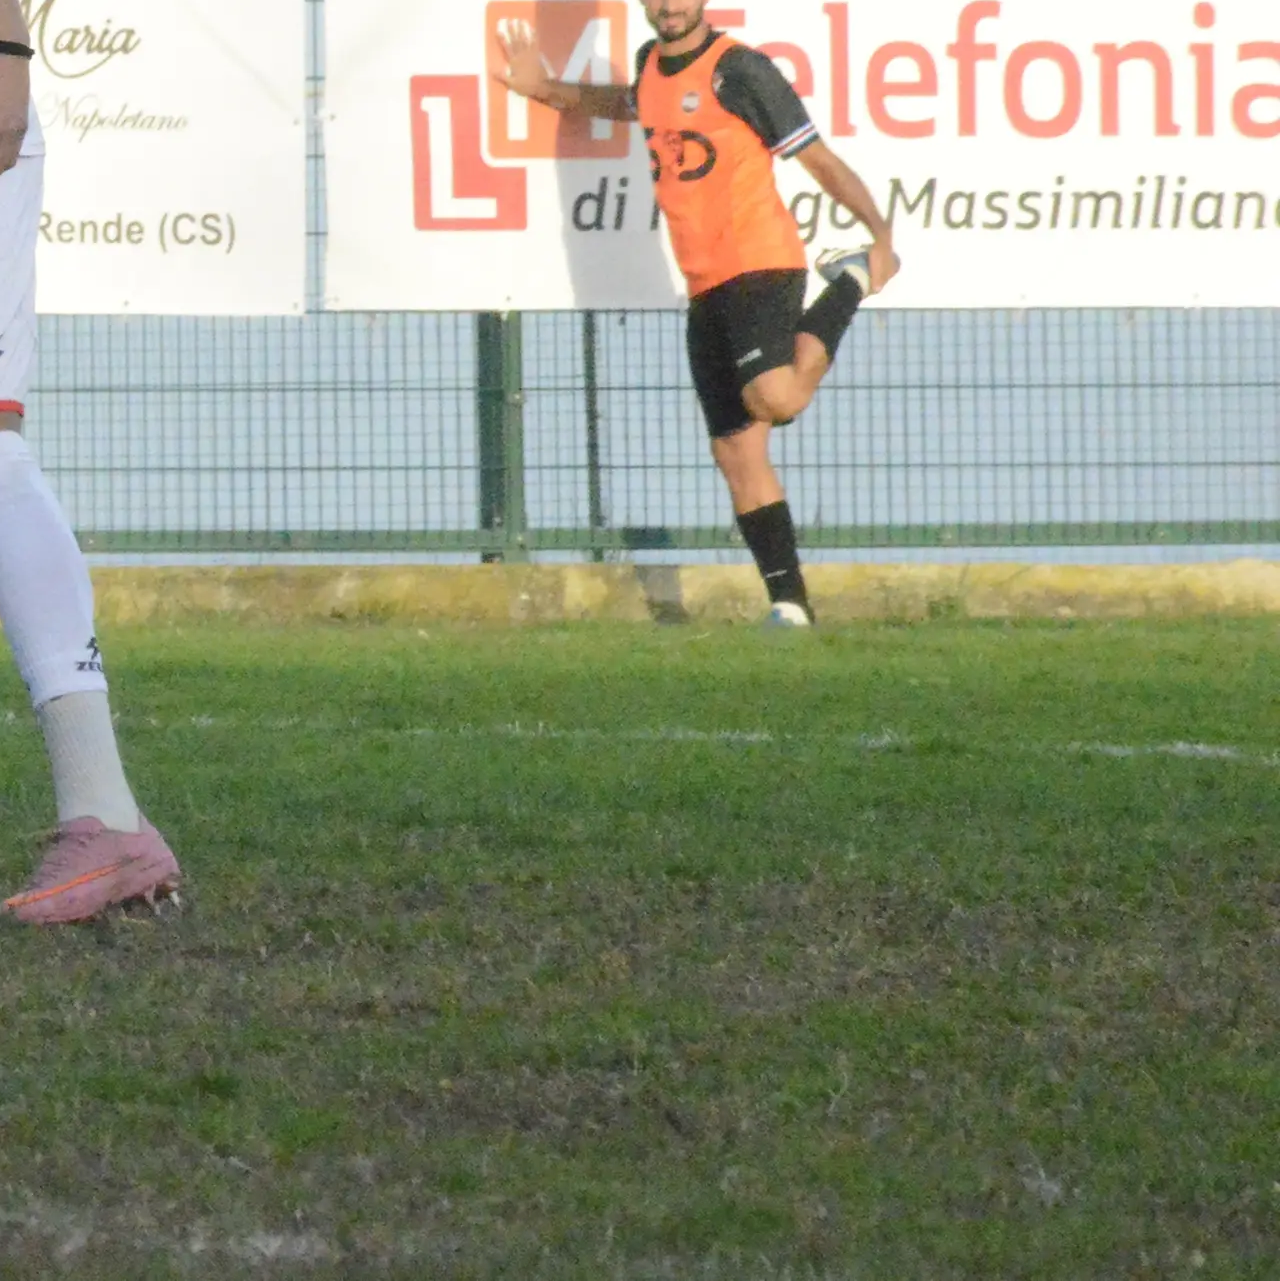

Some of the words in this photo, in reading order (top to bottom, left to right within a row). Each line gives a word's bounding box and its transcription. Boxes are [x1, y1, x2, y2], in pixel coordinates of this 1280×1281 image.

[702, 0, 1280, 139] lefonia
[572, 177, 628, 231] di
[887, 175, 1280, 230] Massimilian
[37, 212, 145, 245] Rende
[158, 212, 237, 254] (CS)
